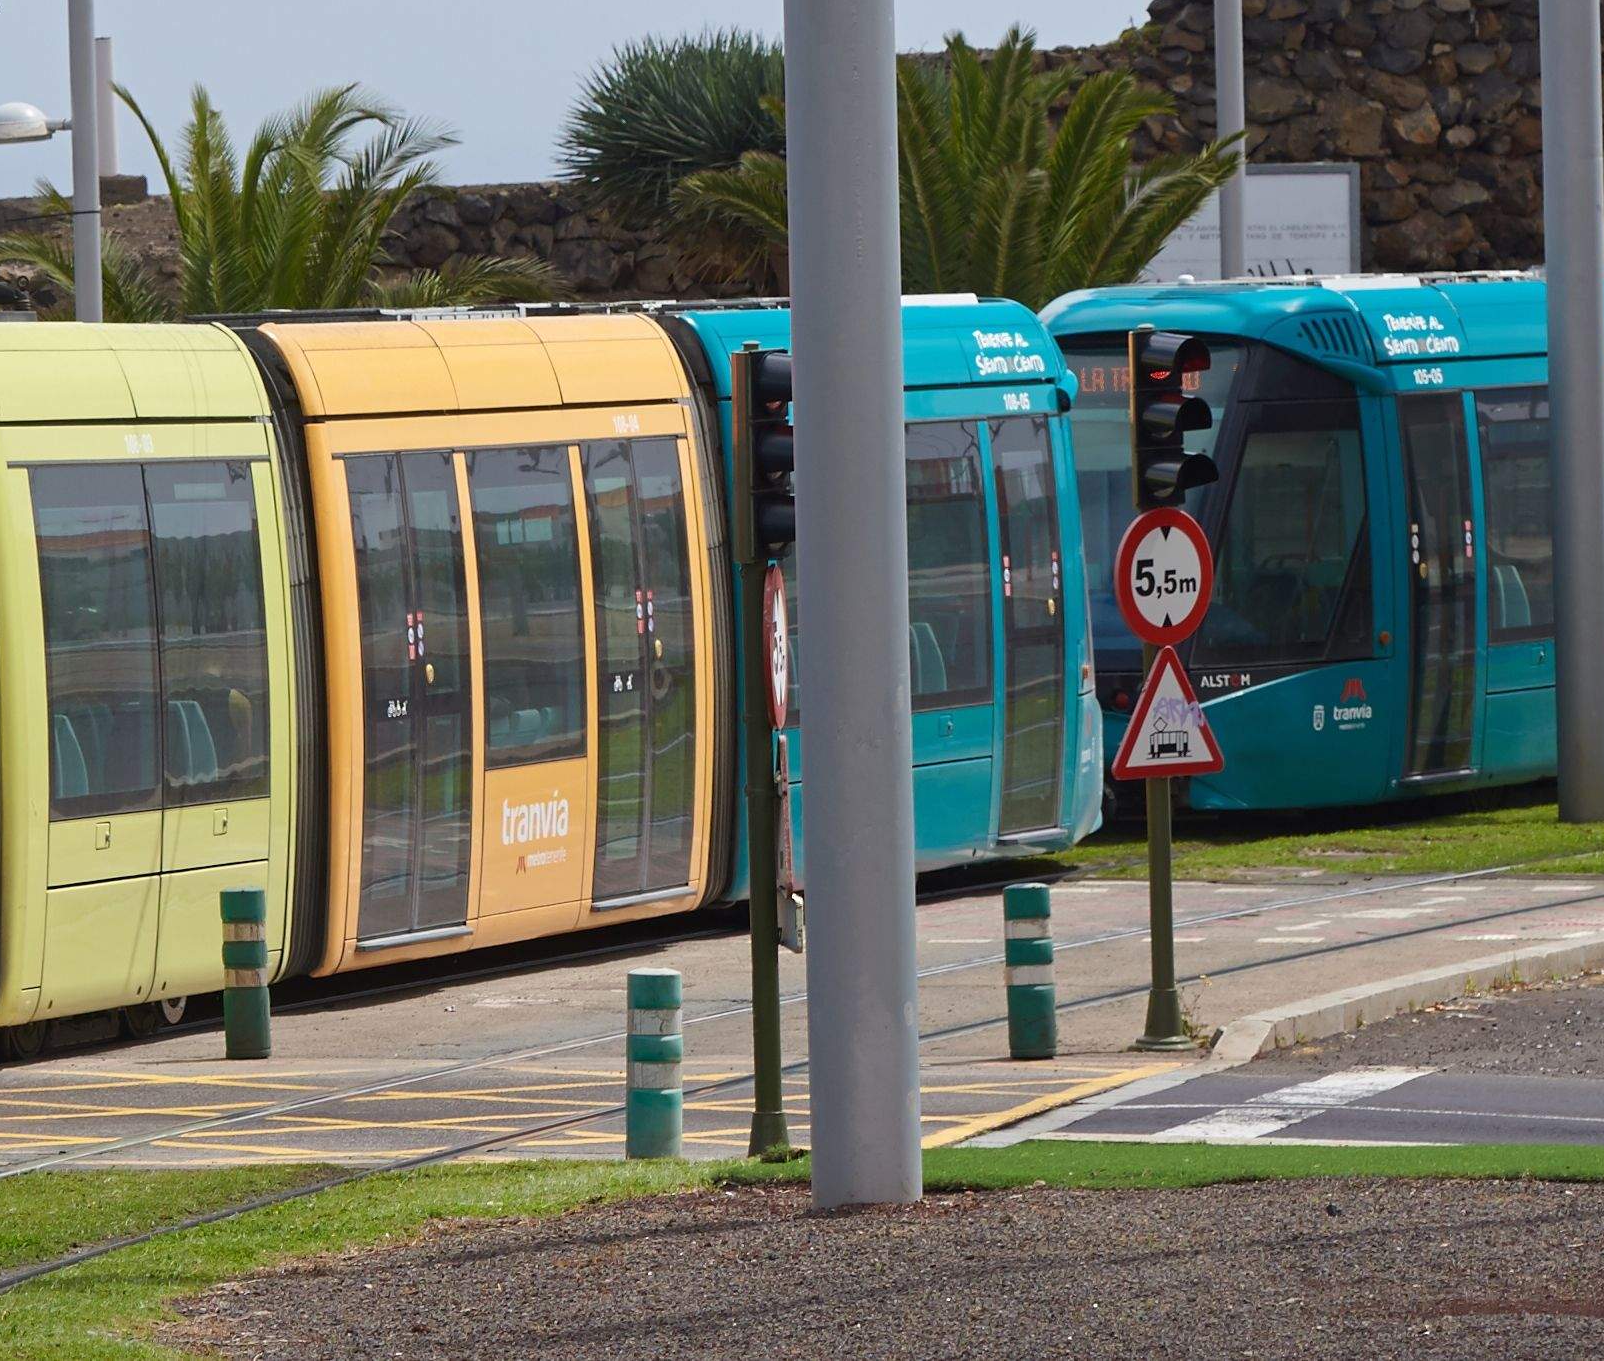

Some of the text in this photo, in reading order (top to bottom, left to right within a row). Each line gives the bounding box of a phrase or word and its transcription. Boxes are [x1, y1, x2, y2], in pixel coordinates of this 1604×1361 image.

[1135, 558, 1197, 599] 5,5m
[1200, 673, 1251, 688] ALSTOM
[502, 789, 569, 846] tranvía
